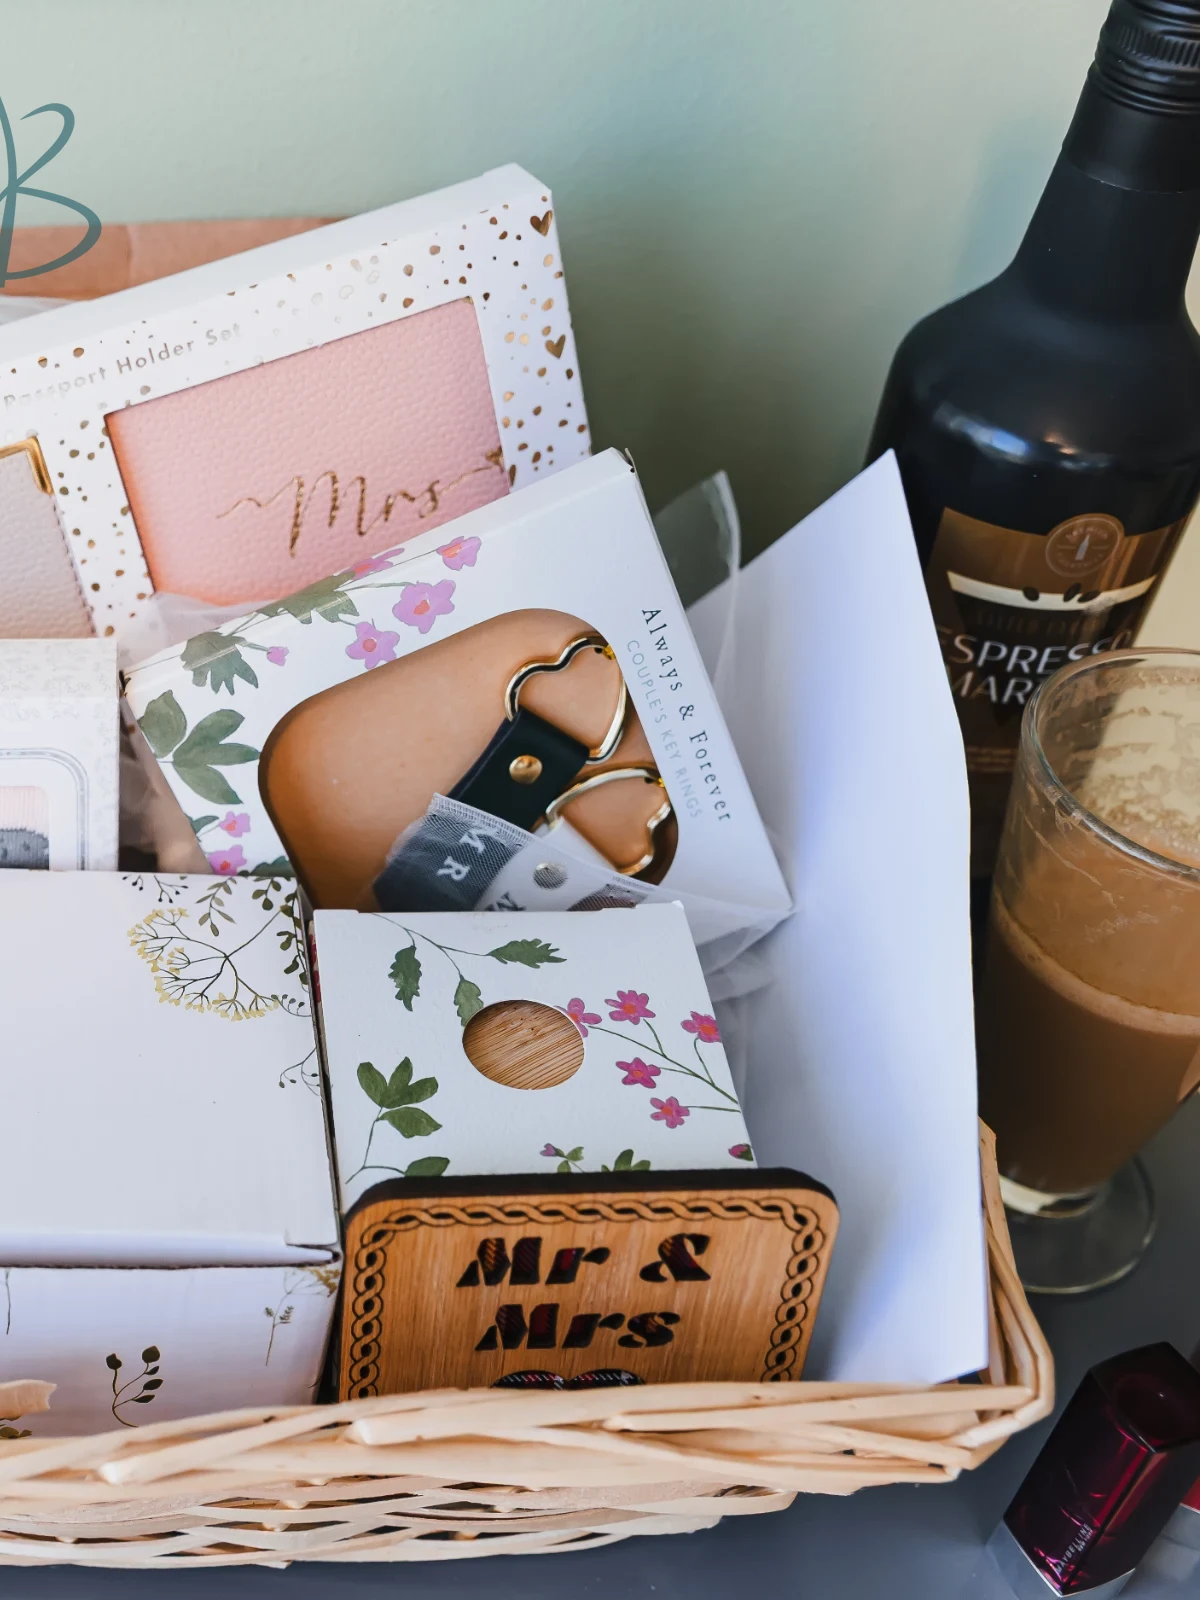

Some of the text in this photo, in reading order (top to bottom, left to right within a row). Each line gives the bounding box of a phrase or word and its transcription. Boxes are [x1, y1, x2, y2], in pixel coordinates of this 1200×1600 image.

[3, 366, 107, 409] Passport
[115, 338, 195, 375] Holder
[204, 322, 242, 347] Set
[216, 464, 498, 558] Mrs
[937, 624, 1132, 676] SPRES
[947, 668, 1042, 705] MAR
[626, 639, 703, 819] COUPLE'S KEY RINGS
[641, 608, 731, 822] Always & Forever
[456, 1233, 712, 1288] Mr &
[474, 1303, 681, 1352] Mrs
[1056, 1522, 1094, 1574] MAYBELLINE
